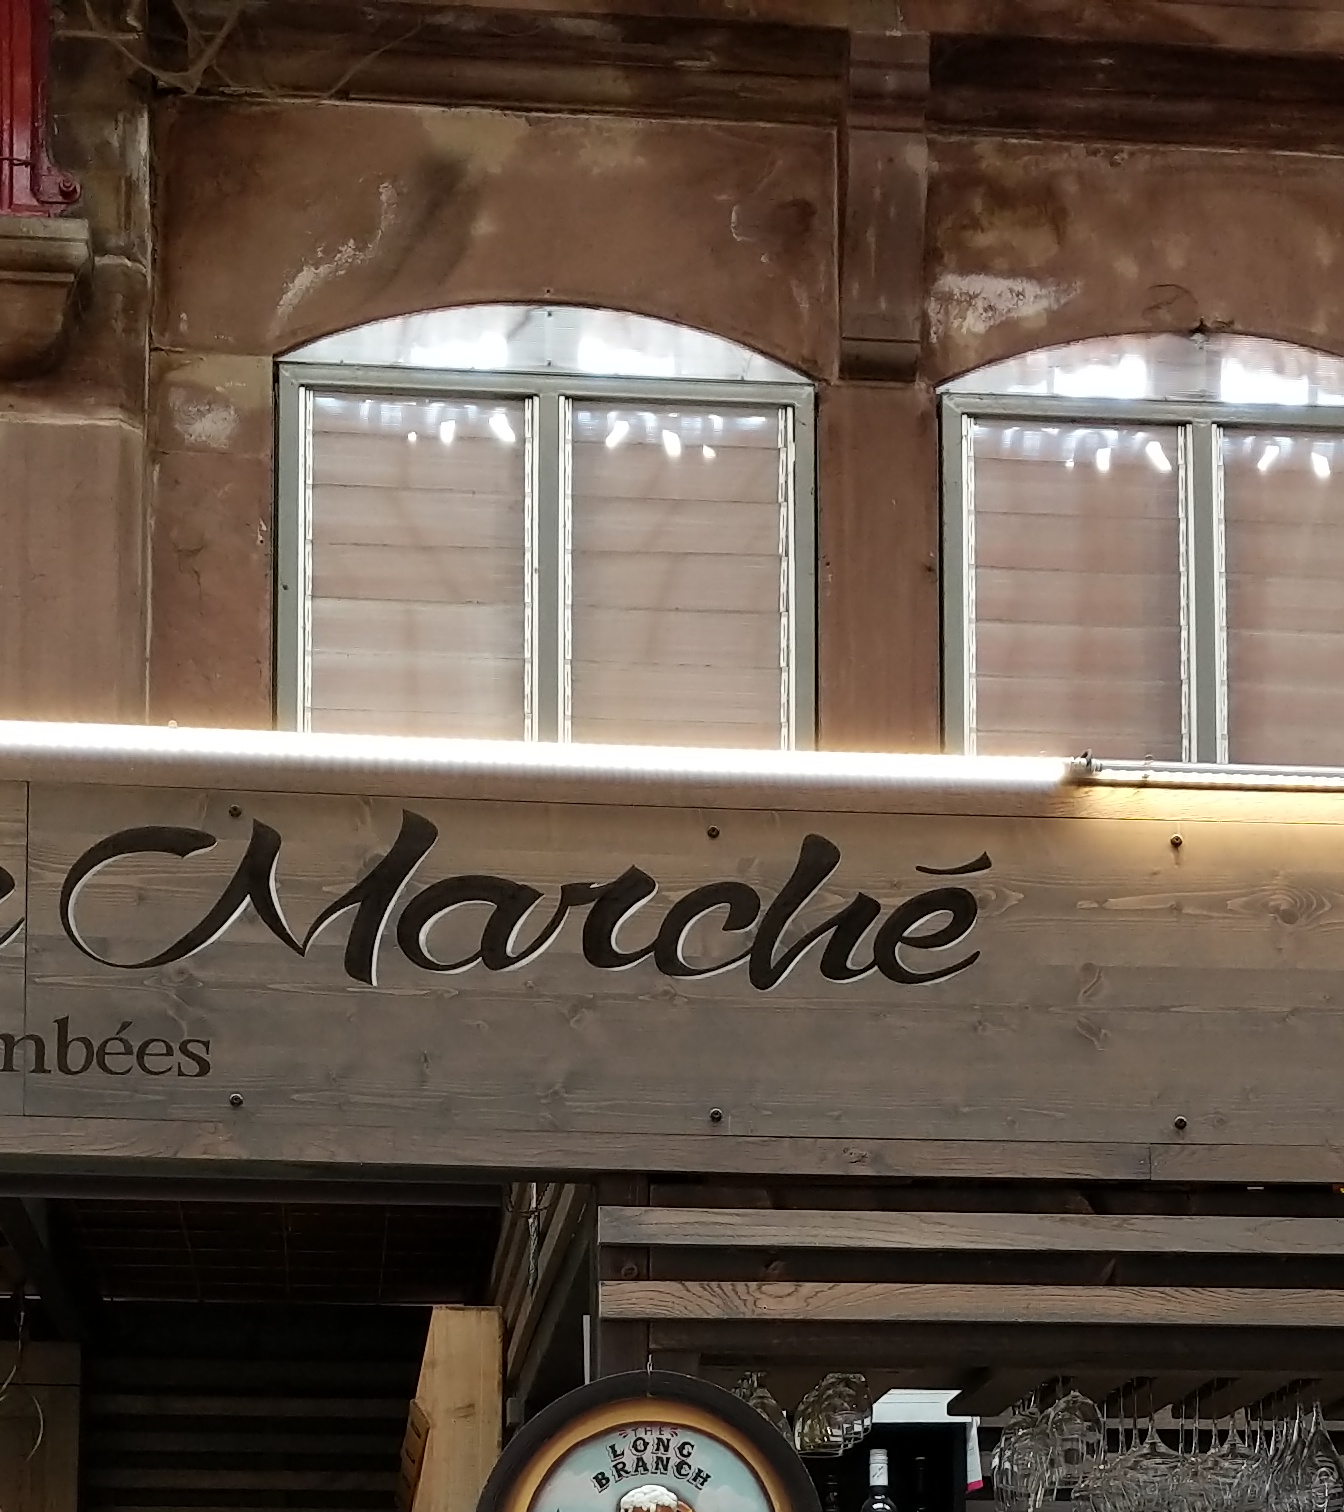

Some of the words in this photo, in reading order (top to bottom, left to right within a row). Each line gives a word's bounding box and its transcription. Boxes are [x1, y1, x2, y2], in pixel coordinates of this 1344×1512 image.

[59, 808, 992, 991] Marché
[632, 1427, 666, 1438] THE
[607, 1436, 696, 1462] LONG
[591, 1455, 713, 1493] BRANCH
